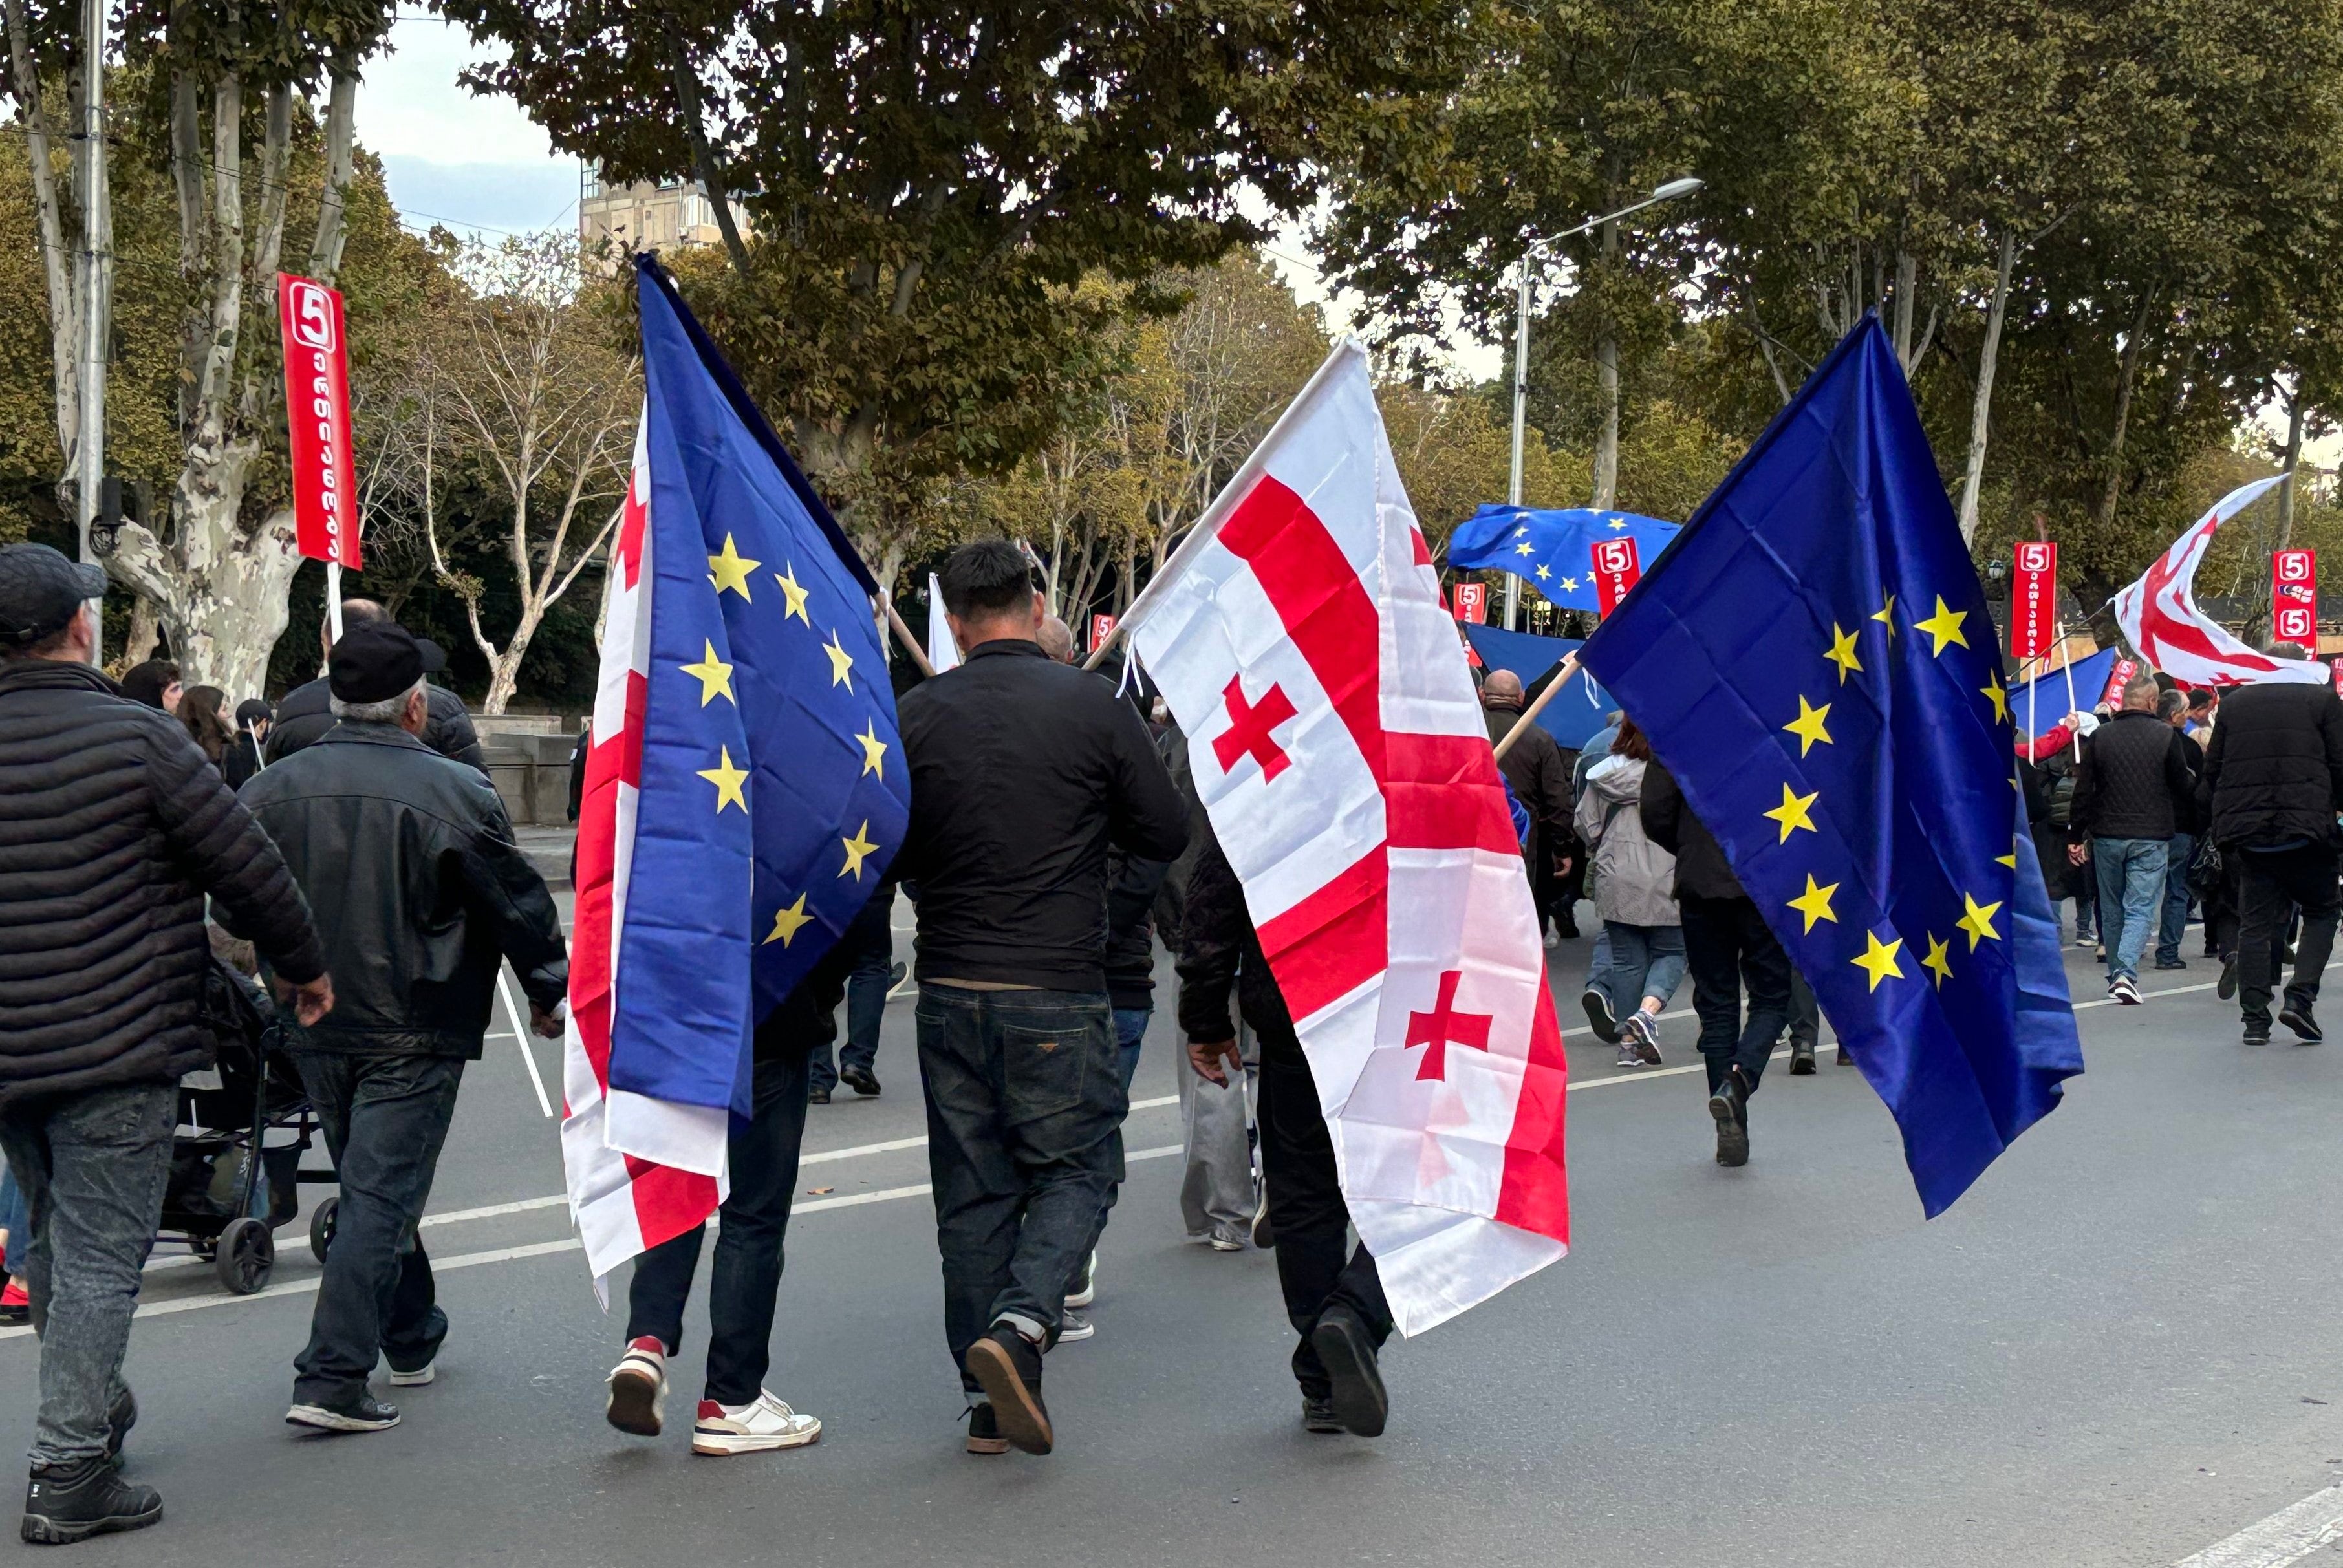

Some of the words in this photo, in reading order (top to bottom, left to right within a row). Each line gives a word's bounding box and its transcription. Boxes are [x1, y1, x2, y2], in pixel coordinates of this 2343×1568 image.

[300, 288, 329, 346] 5
[1606, 543, 1626, 571] 5
[2025, 546, 2045, 569] 5
[2285, 555, 2304, 578] 5
[1462, 585, 1477, 604] 5
[1098, 618, 1109, 638] 5
[2285, 609, 2305, 634] 5
